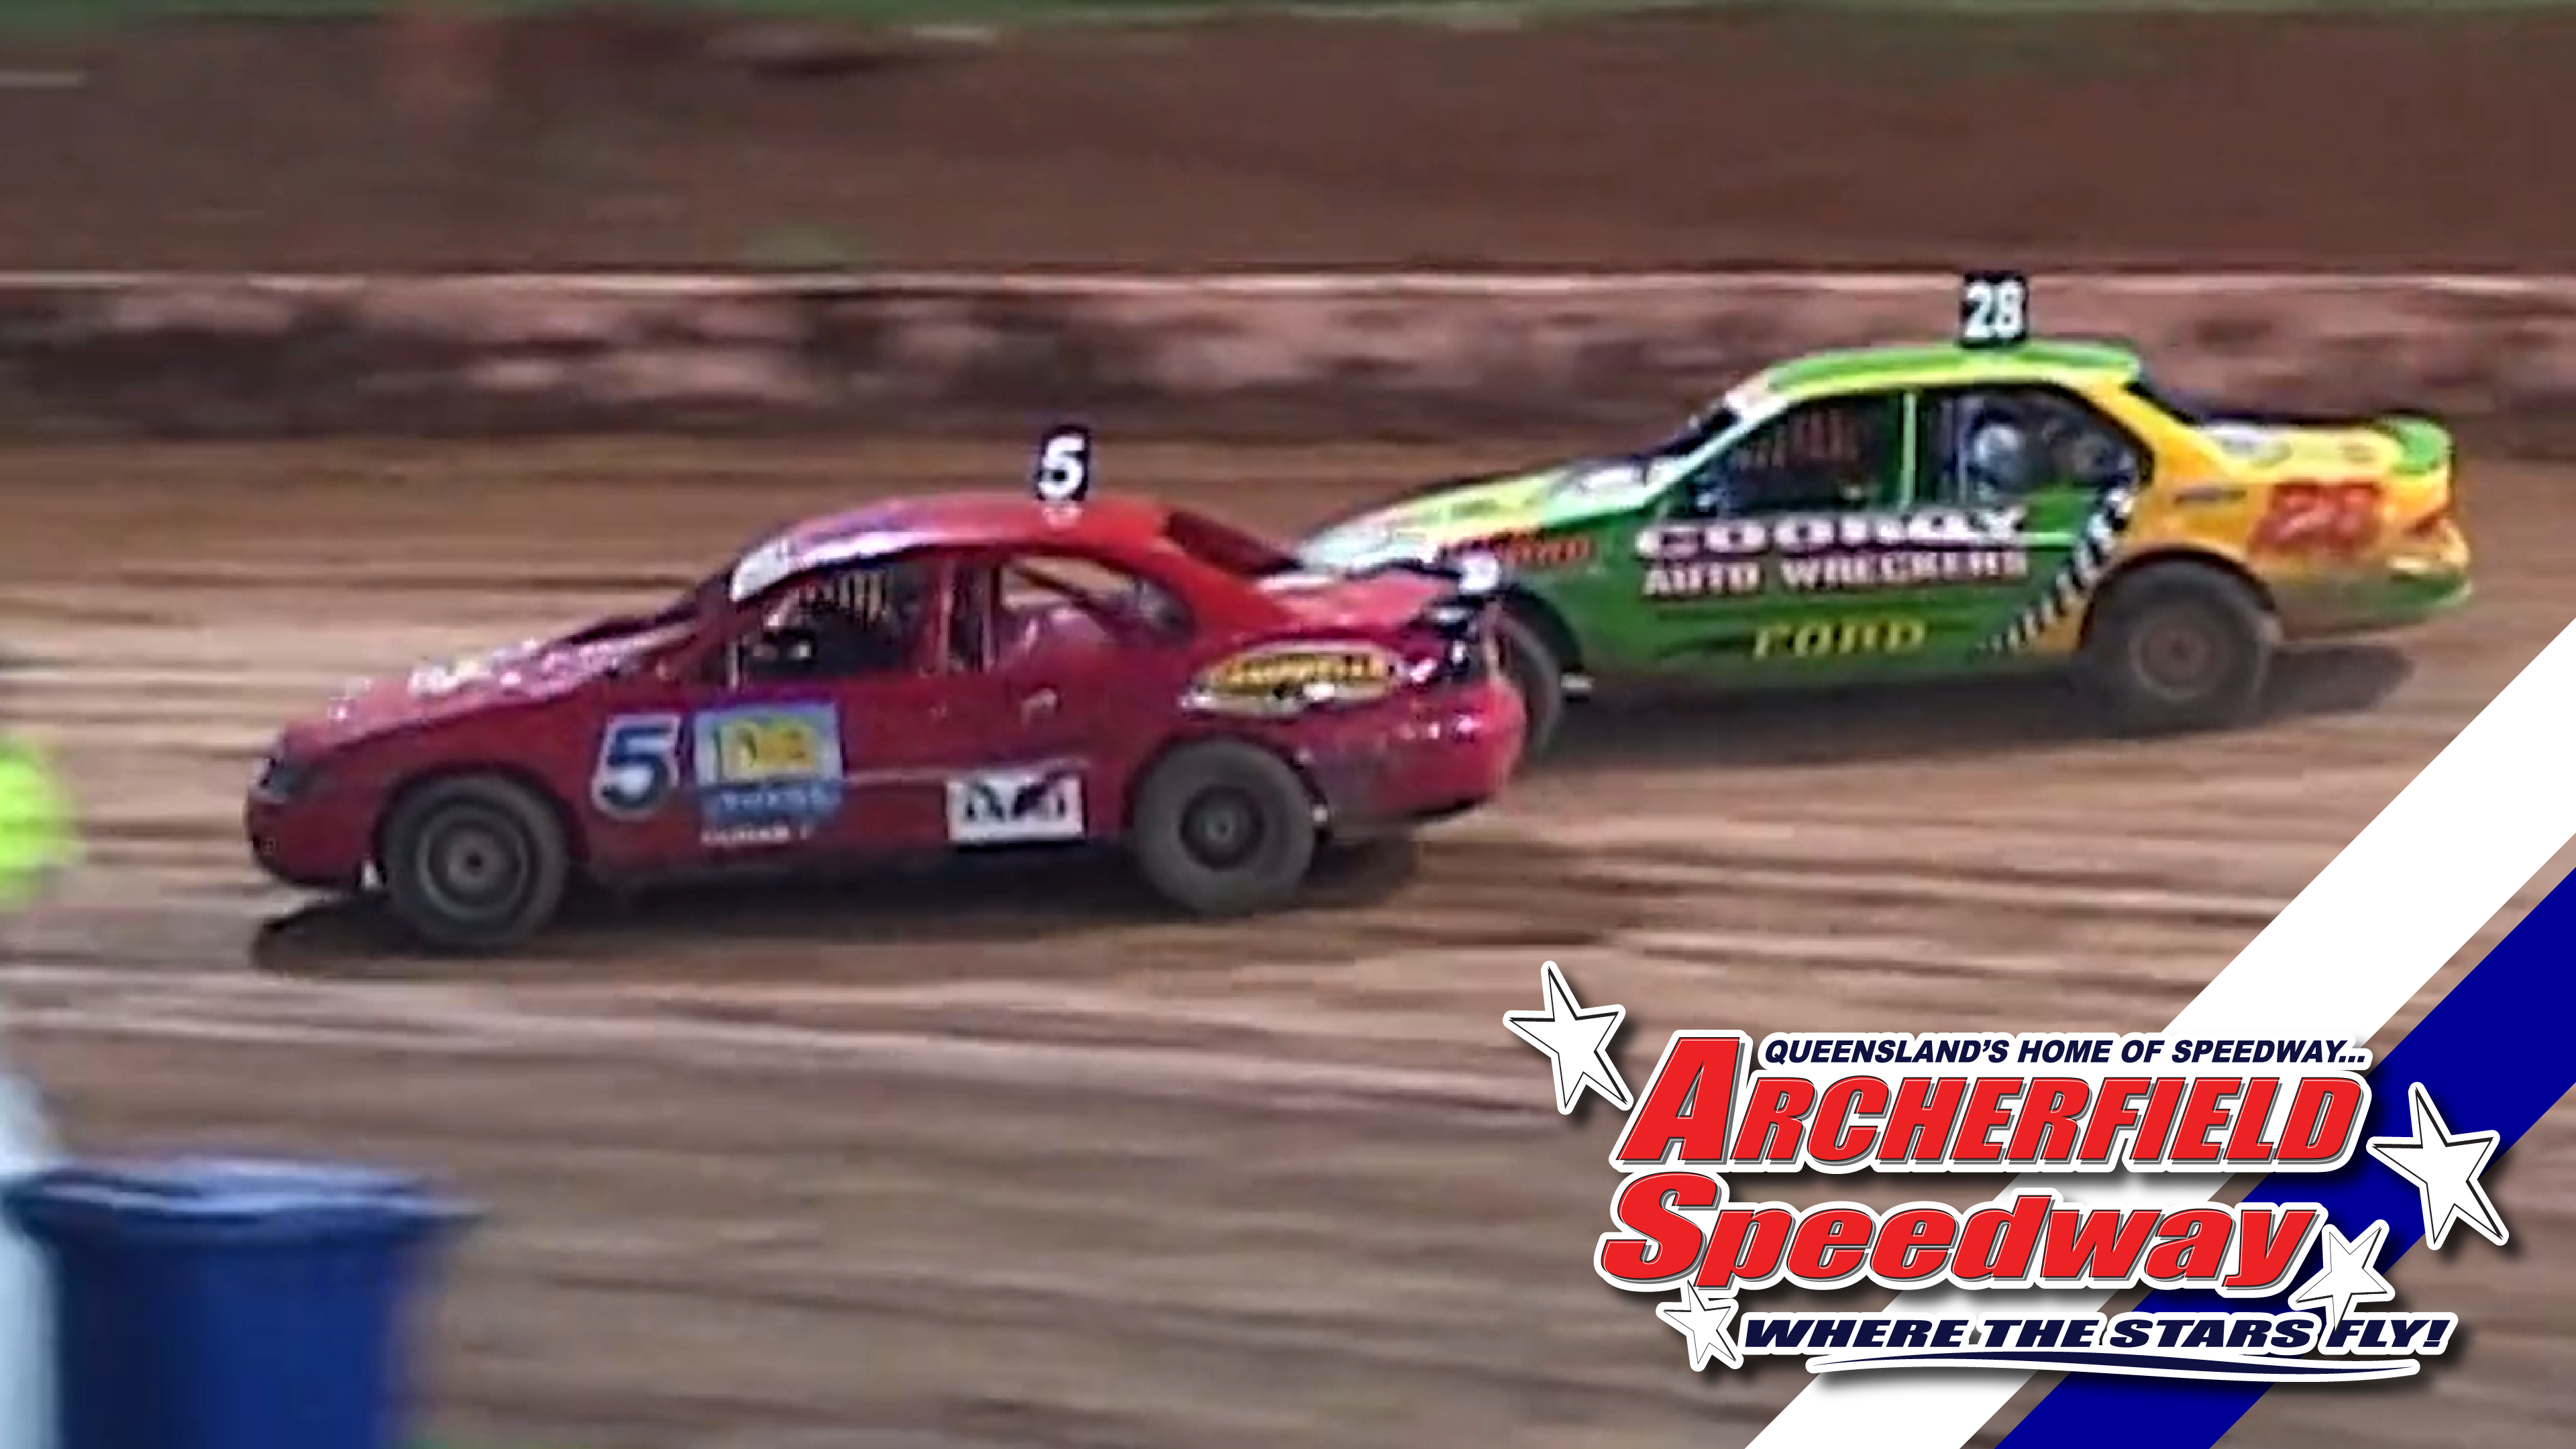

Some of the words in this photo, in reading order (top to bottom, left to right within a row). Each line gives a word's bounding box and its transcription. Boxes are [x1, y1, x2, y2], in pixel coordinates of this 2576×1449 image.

[1963, 280, 2023, 339] 28
[1038, 435, 1085, 499] 5
[1642, 561, 1763, 597] AUTO
[1778, 550, 2029, 589] WRECKERS
[1752, 617, 1927, 661] FORD
[596, 716, 678, 817] 5
